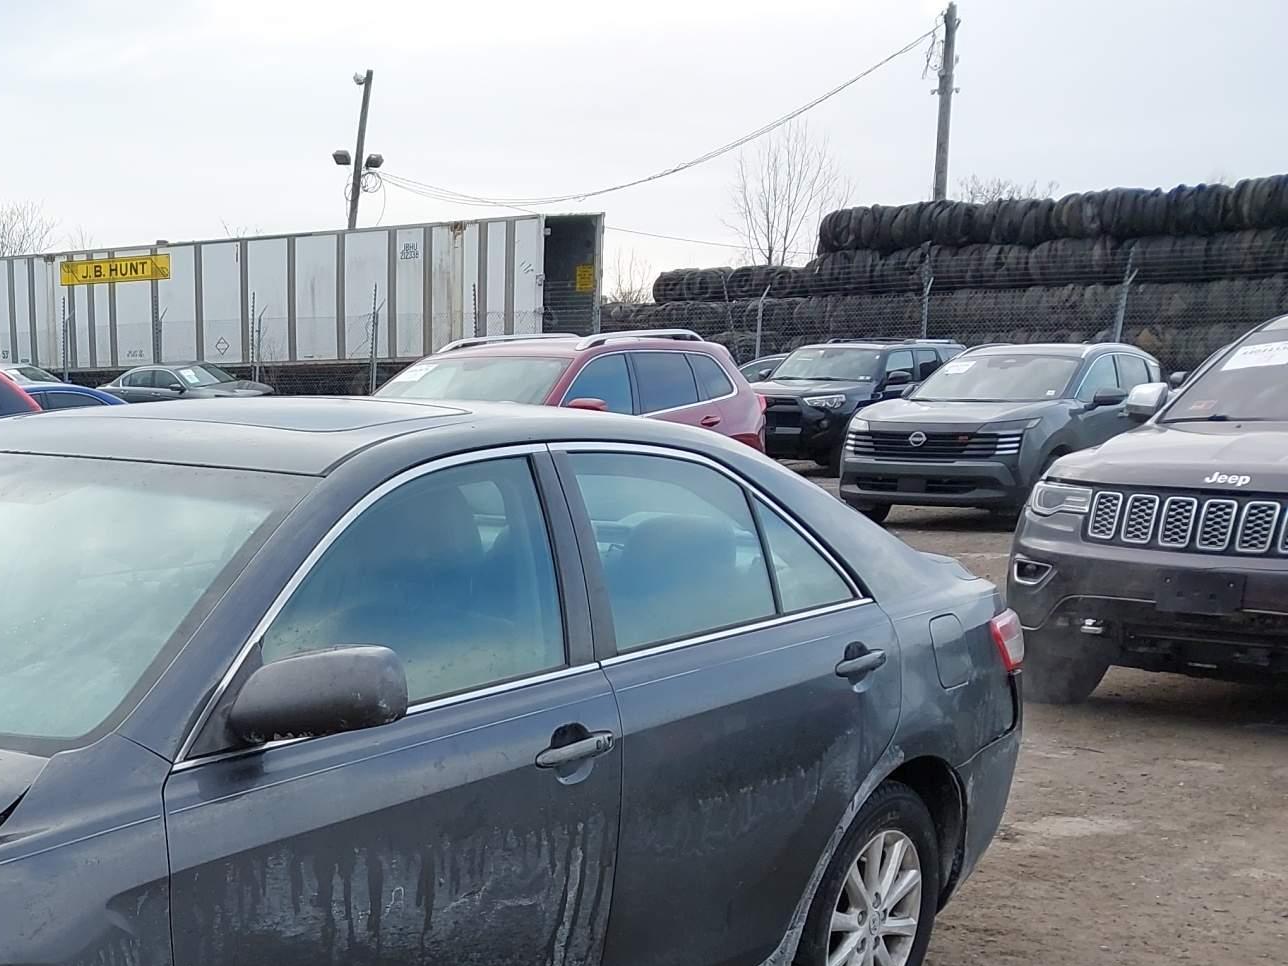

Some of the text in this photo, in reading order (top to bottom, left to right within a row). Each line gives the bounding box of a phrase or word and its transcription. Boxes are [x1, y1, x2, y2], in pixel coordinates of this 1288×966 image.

[81, 261, 148, 279] J. B. HUNT
[1204, 471, 1251, 487] Jeep
